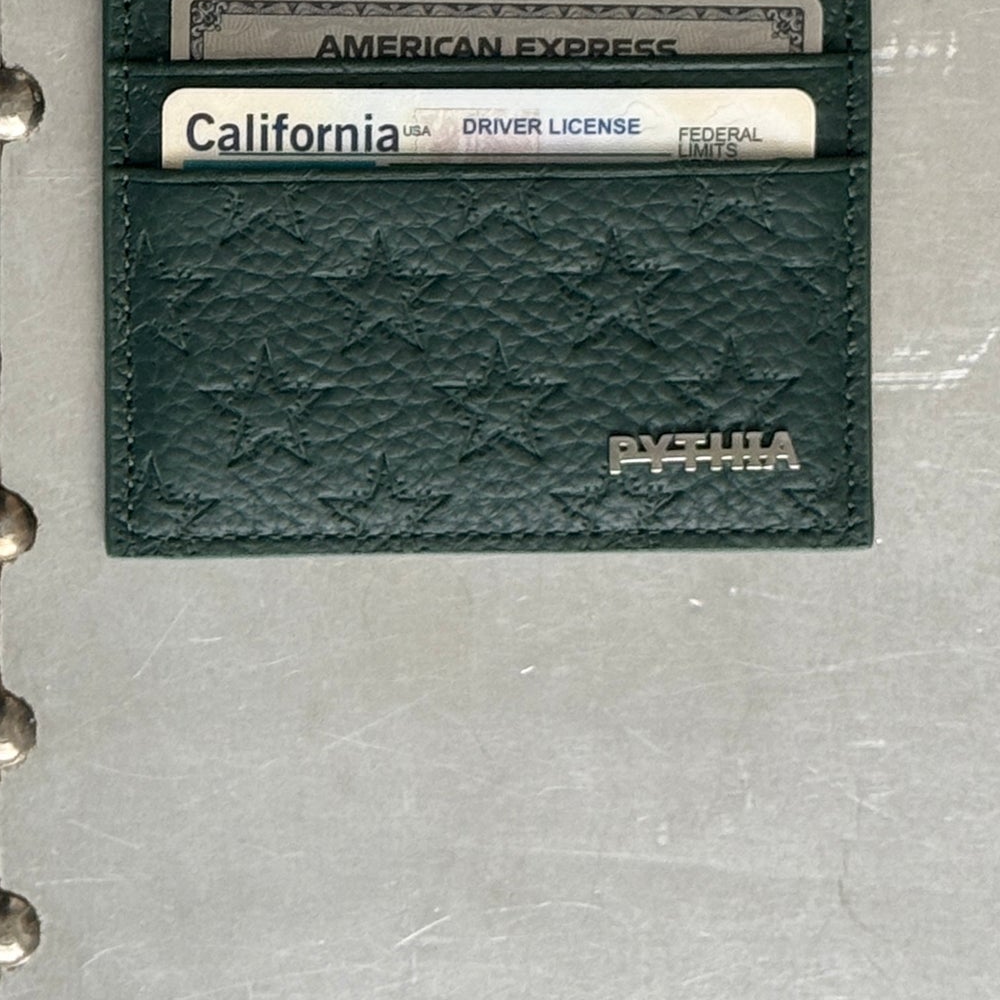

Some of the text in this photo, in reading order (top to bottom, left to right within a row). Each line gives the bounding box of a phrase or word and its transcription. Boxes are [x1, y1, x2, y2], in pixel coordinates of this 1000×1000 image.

[314, 35, 677, 59] AMERICAN EXPRESS
[186, 112, 431, 152] California USA
[463, 118, 641, 135] DRIVER LICENSE
[679, 127, 763, 142] FEDERAL
[678, 143, 738, 159] LIMITS
[608, 431, 800, 475] PYTHIA
